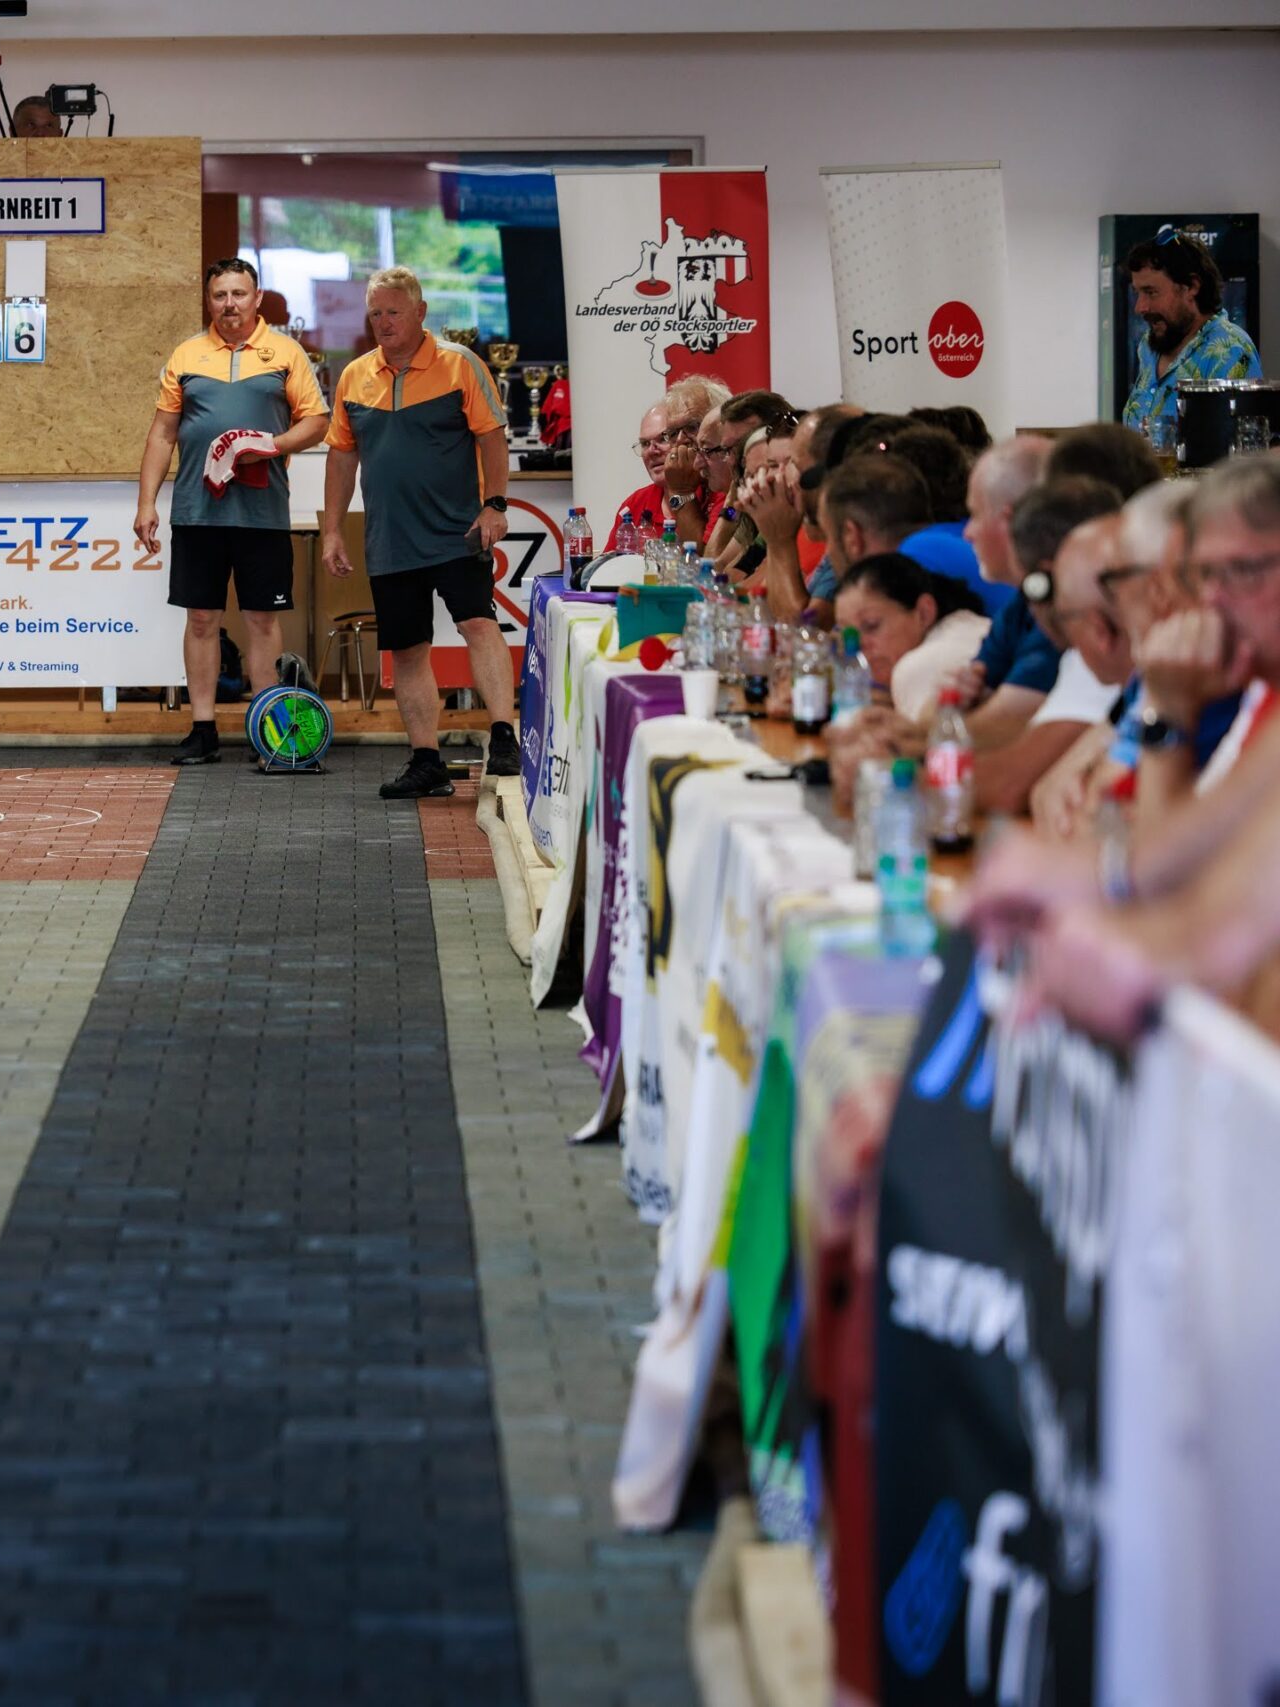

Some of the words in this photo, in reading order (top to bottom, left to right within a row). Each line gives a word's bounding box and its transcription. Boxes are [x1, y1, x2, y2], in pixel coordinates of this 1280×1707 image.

[67, 197, 77, 219] 1
[575, 303, 678, 316] Landesverband
[613, 320, 640, 332] der
[640, 317, 660, 332] OÖ
[663, 319, 755, 334] Stocksportler
[14, 322, 35, 354] 6
[852, 329, 919, 362] Sport
[928, 324, 984, 348] ober
[937, 353, 975, 362] österreich
[5, 539, 163, 571] 4222
[15, 618, 60, 633] beim
[66, 618, 139, 633] Service.
[7, 662, 16, 671] &
[20, 661, 79, 673] Streaming
